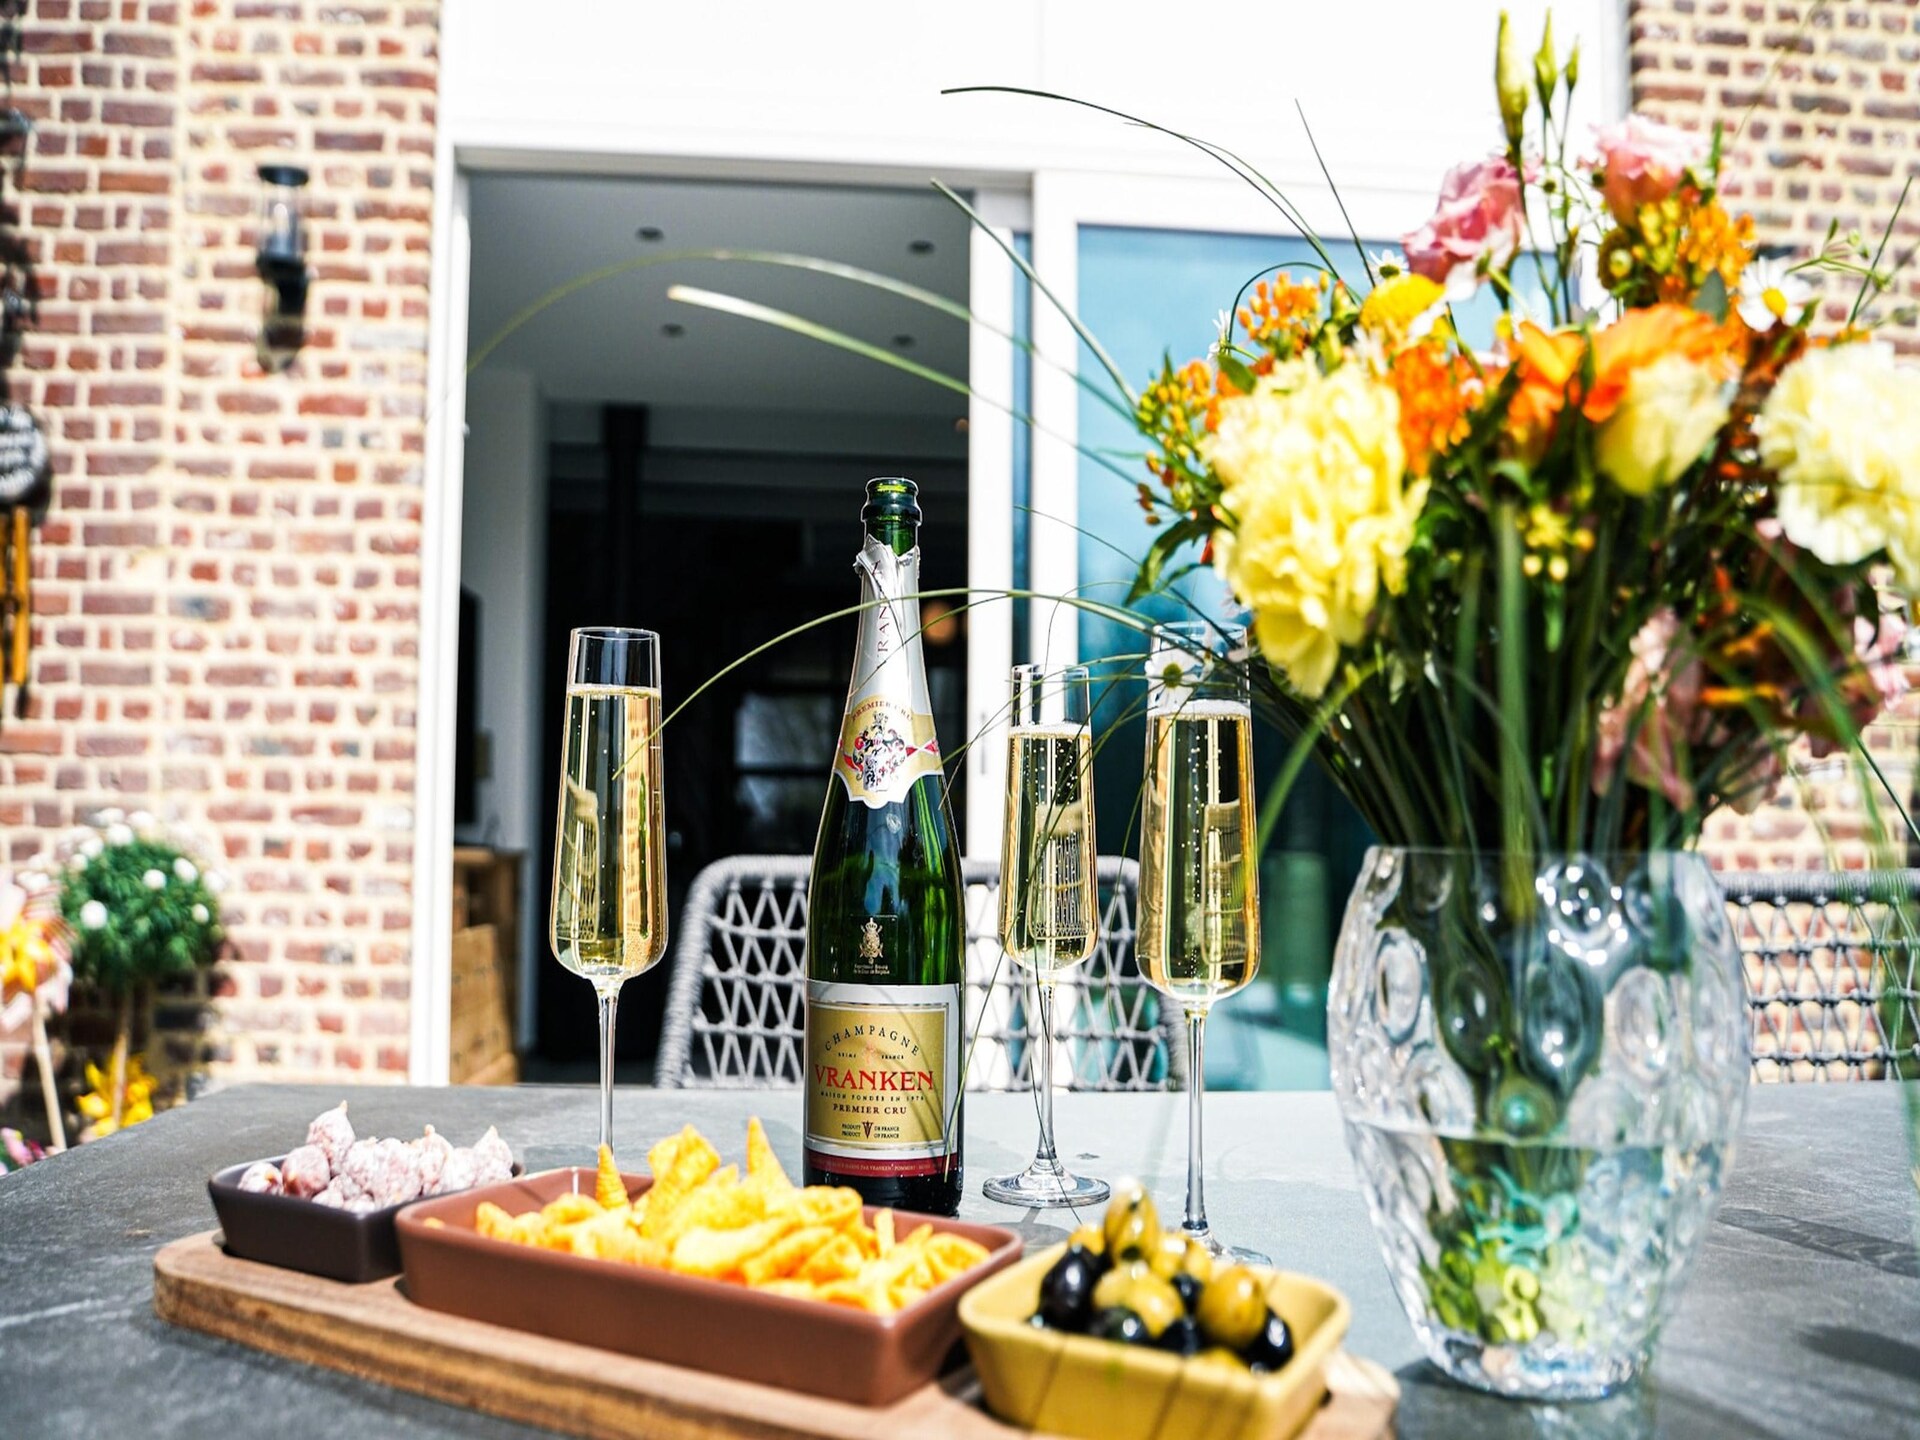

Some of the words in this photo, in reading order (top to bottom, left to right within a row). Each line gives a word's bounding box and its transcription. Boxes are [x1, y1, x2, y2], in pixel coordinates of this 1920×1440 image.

[825, 1025, 919, 1056] CHAMPAGNE
[814, 1064, 934, 1092] VRANKEN
[820, 1091, 847, 1099] MAISON
[832, 1103, 880, 1115] PREMIER
[884, 1106, 908, 1115] CRU
